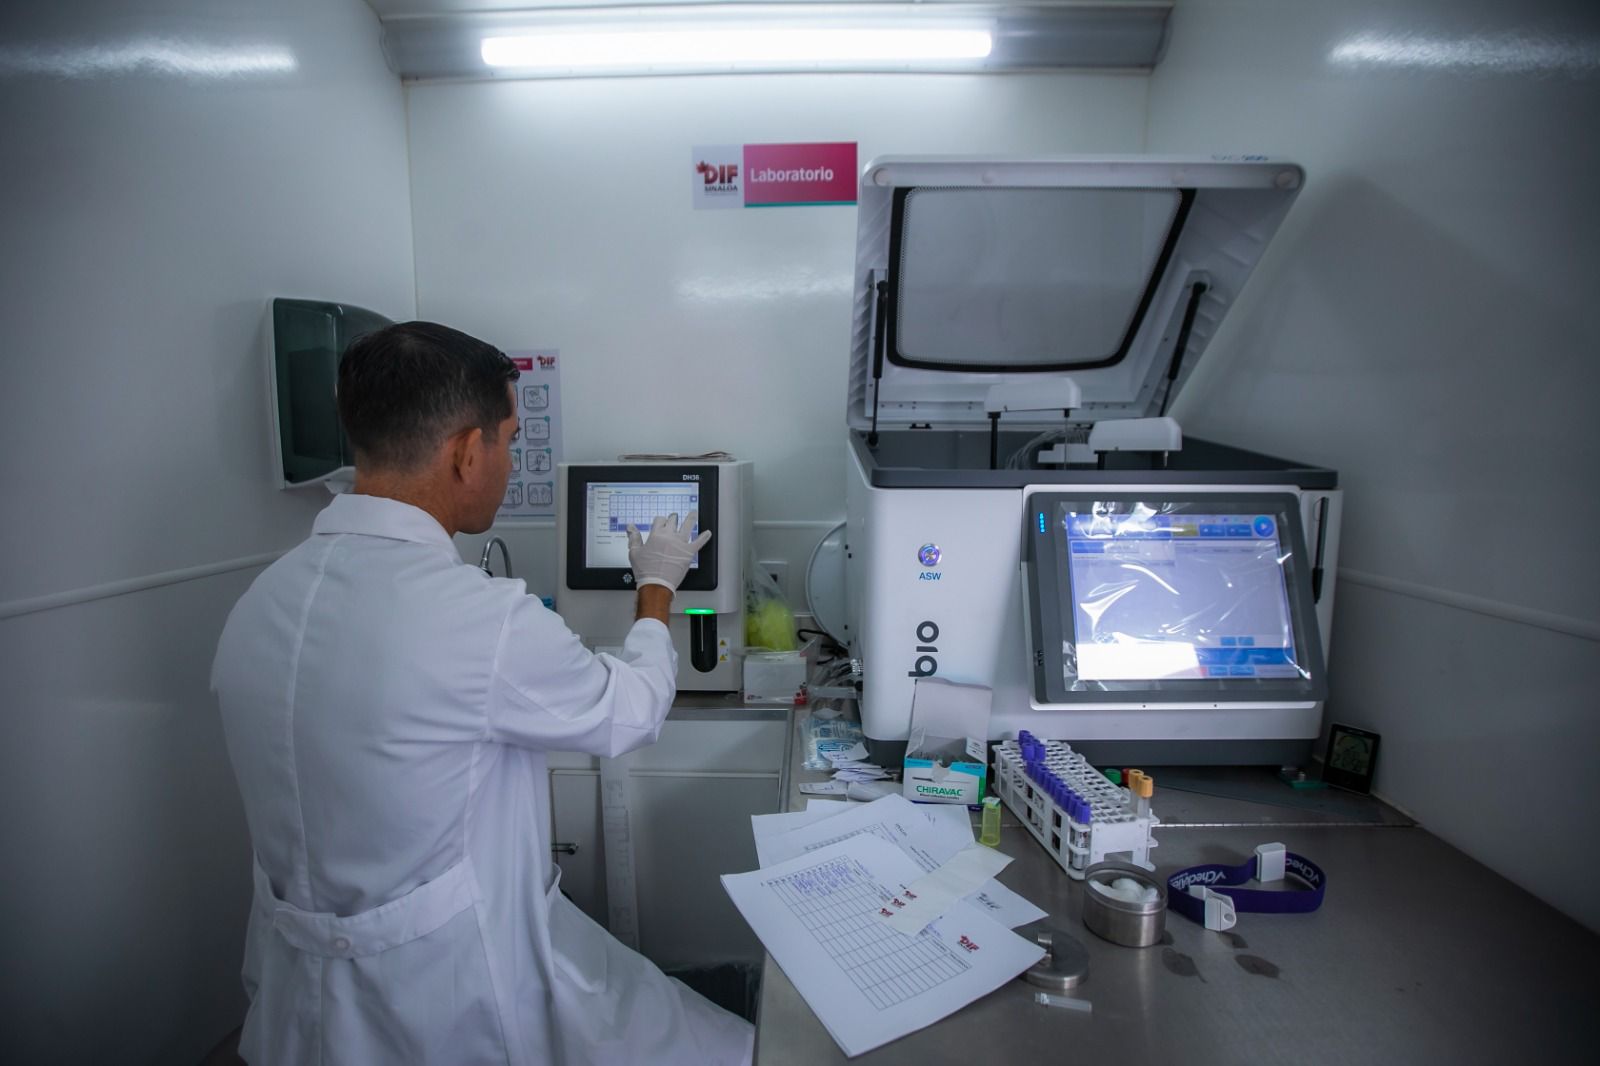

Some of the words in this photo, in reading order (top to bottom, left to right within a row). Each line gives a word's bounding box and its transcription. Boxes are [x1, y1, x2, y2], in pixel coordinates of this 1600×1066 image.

[703, 164, 738, 184] DIF
[750, 166, 834, 183] Laboratorio
[540, 356, 556, 366] DIF
[919, 572, 942, 581] ASW
[916, 785, 965, 797] CHIRAVAC
